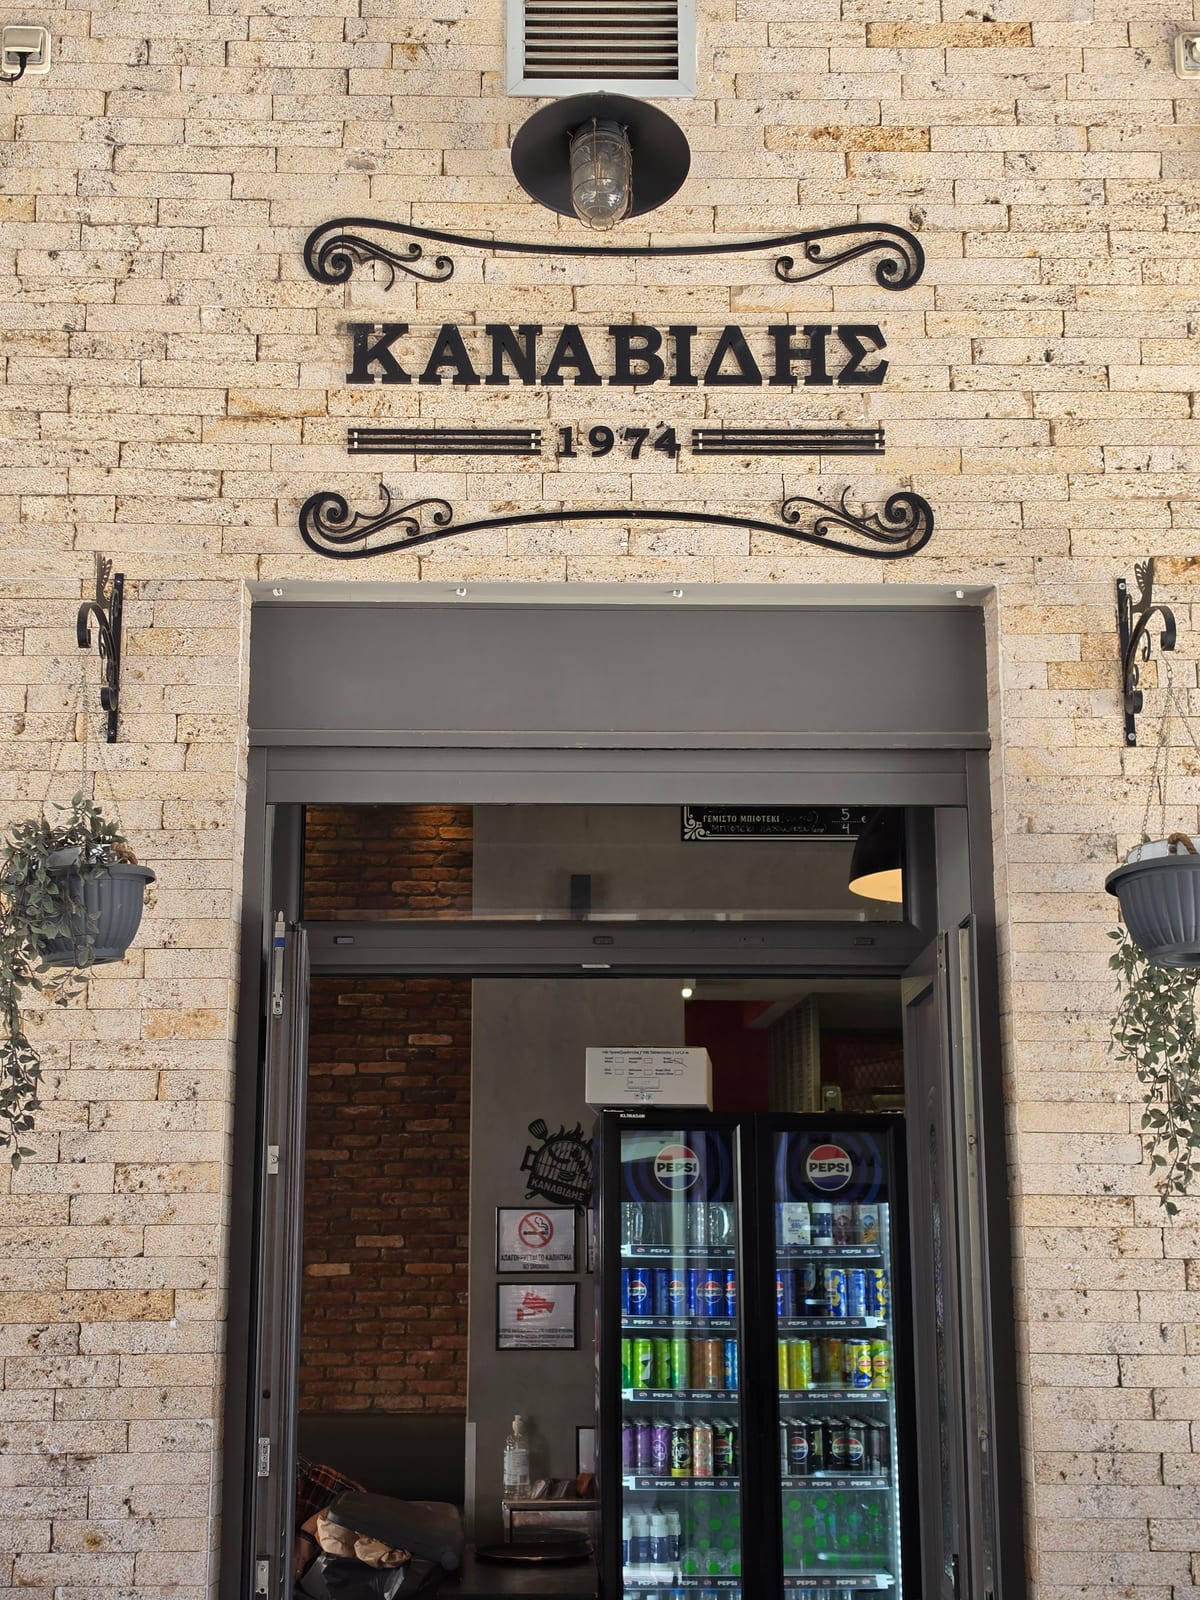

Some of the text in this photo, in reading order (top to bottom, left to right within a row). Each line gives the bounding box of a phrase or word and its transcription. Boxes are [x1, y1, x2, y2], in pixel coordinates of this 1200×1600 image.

[346, 322, 890, 386] ΚΑΝΑΒΙΔΗΣ
[557, 424, 682, 460] 1974
[703, 814, 738, 823] ΓΕΜΙΣΤΟ
[740, 814, 780, 823] ΜΠΙΦΤΕΚΙ
[657, 1162, 697, 1172] PEPSI
[809, 1162, 849, 1173] PEPSI
[531, 1178, 585, 1202] ΚΑΝΑΒΙΔΗΣ
